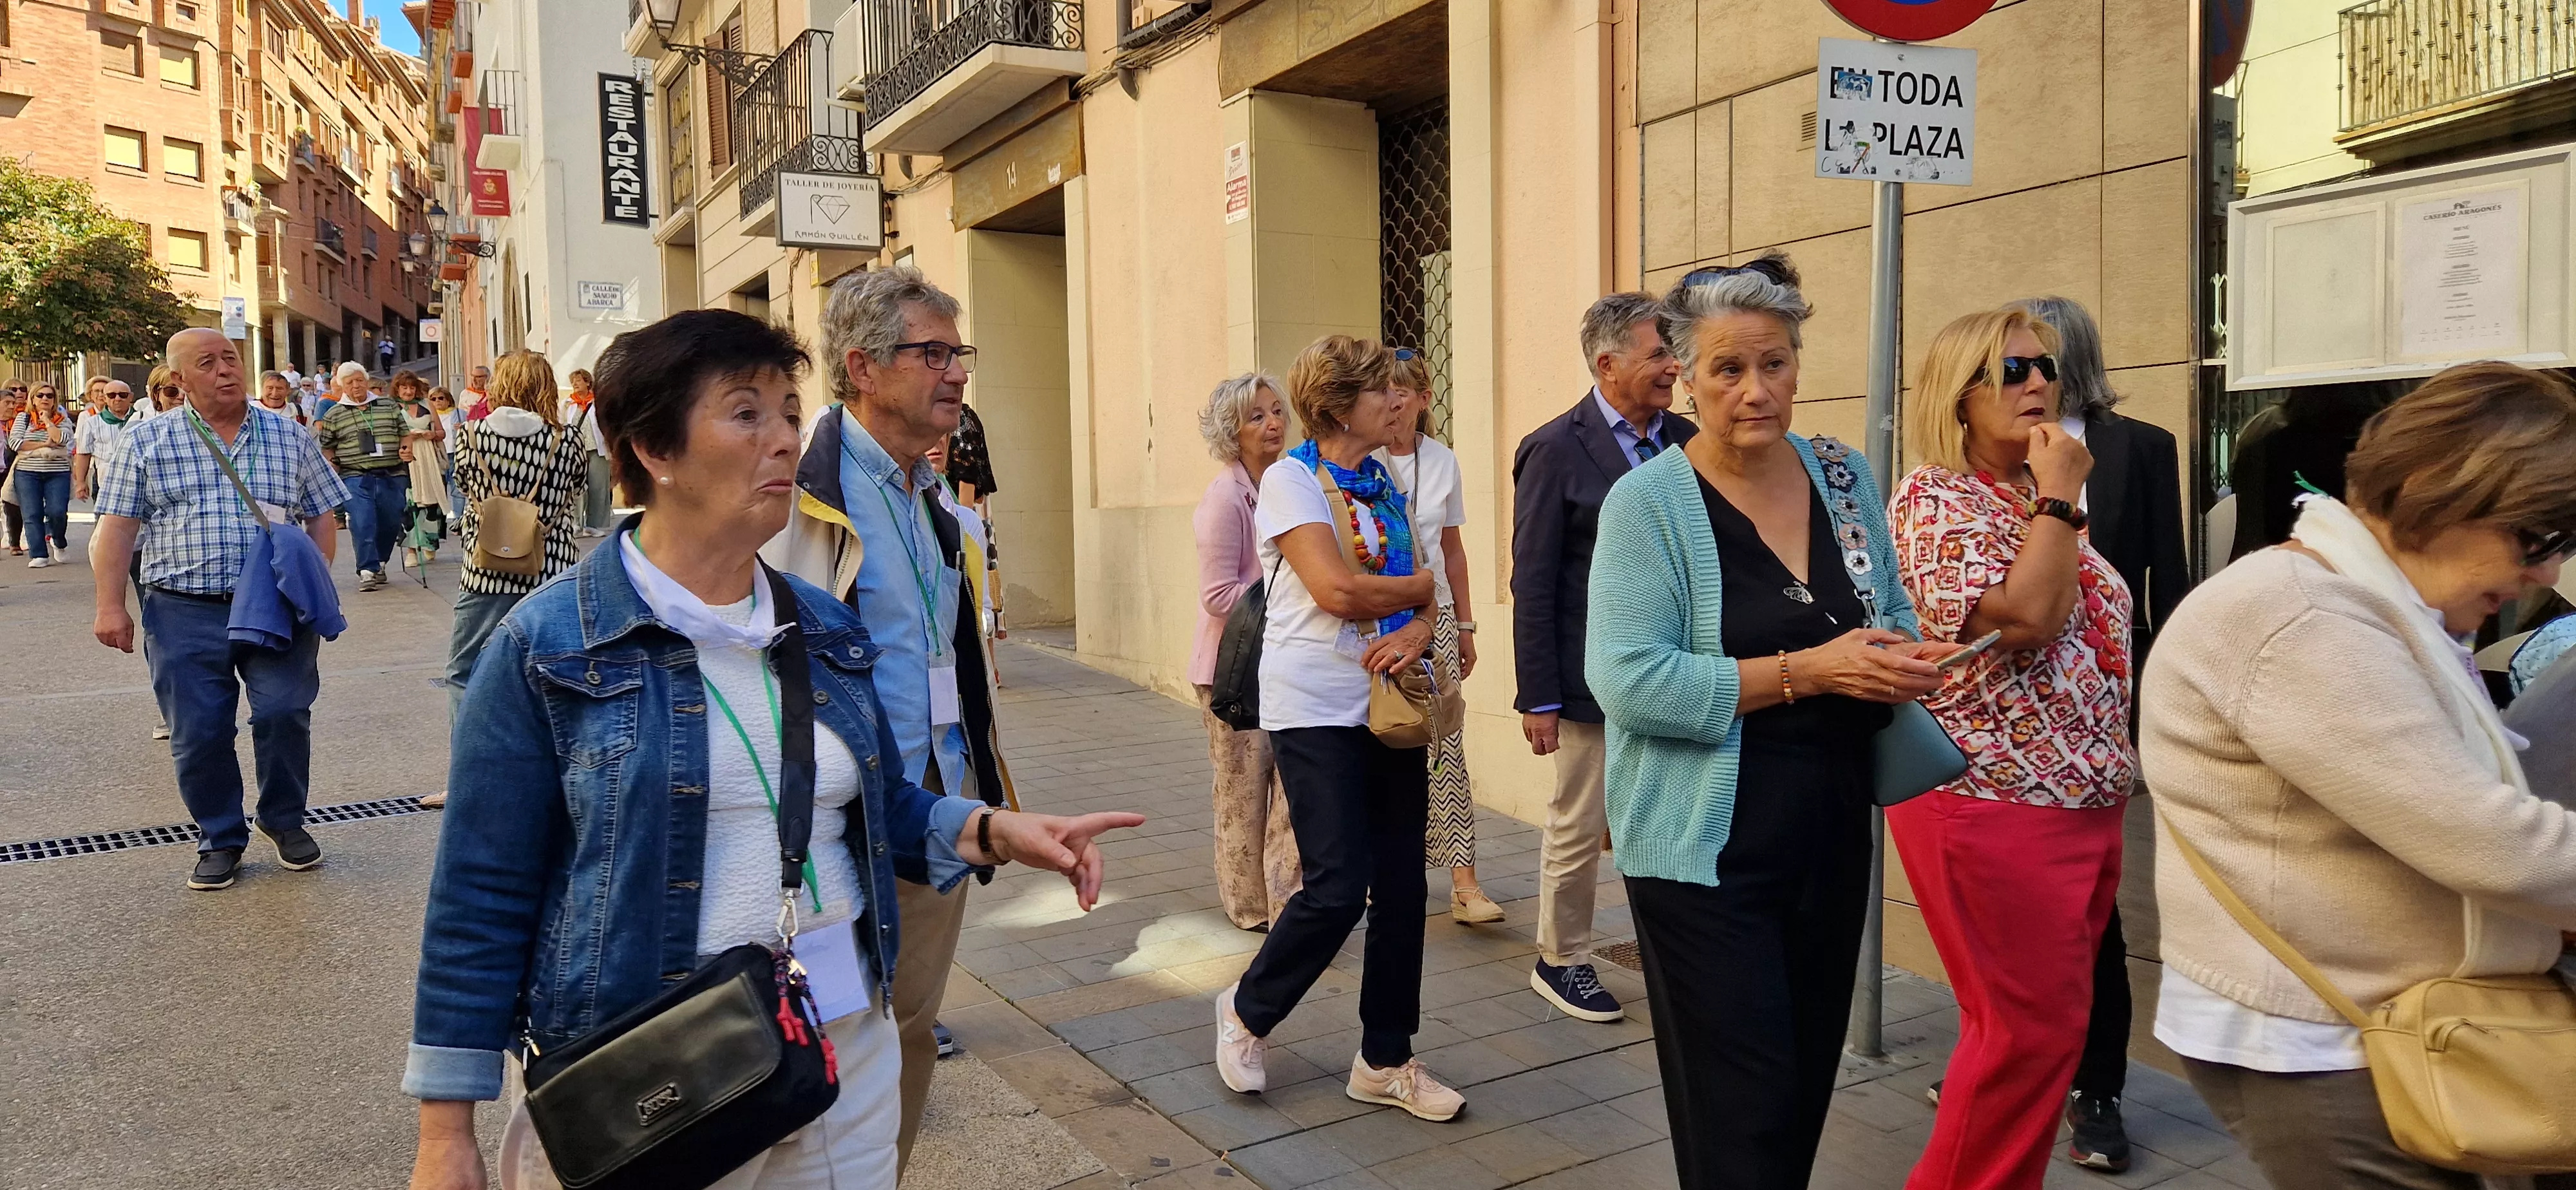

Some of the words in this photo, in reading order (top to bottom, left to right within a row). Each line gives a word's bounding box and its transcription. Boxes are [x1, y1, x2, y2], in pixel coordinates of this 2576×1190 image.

[1830, 66, 1867, 100] E
[1878, 70, 1964, 108] TODA
[605, 79, 641, 219] RESTAURANTE
[1873, 122, 1965, 160] PLAZA
[785, 179, 820, 188] TALLER
[837, 182, 875, 192] JOYERÍA
[1005, 161, 1017, 190] 14
[1227, 179, 1247, 193] Alarma
[2458, 204, 2502, 216] ARAGONÉS
[795, 230, 826, 239] RAMÓN
[828, 232, 869, 241] GUILLÉN
